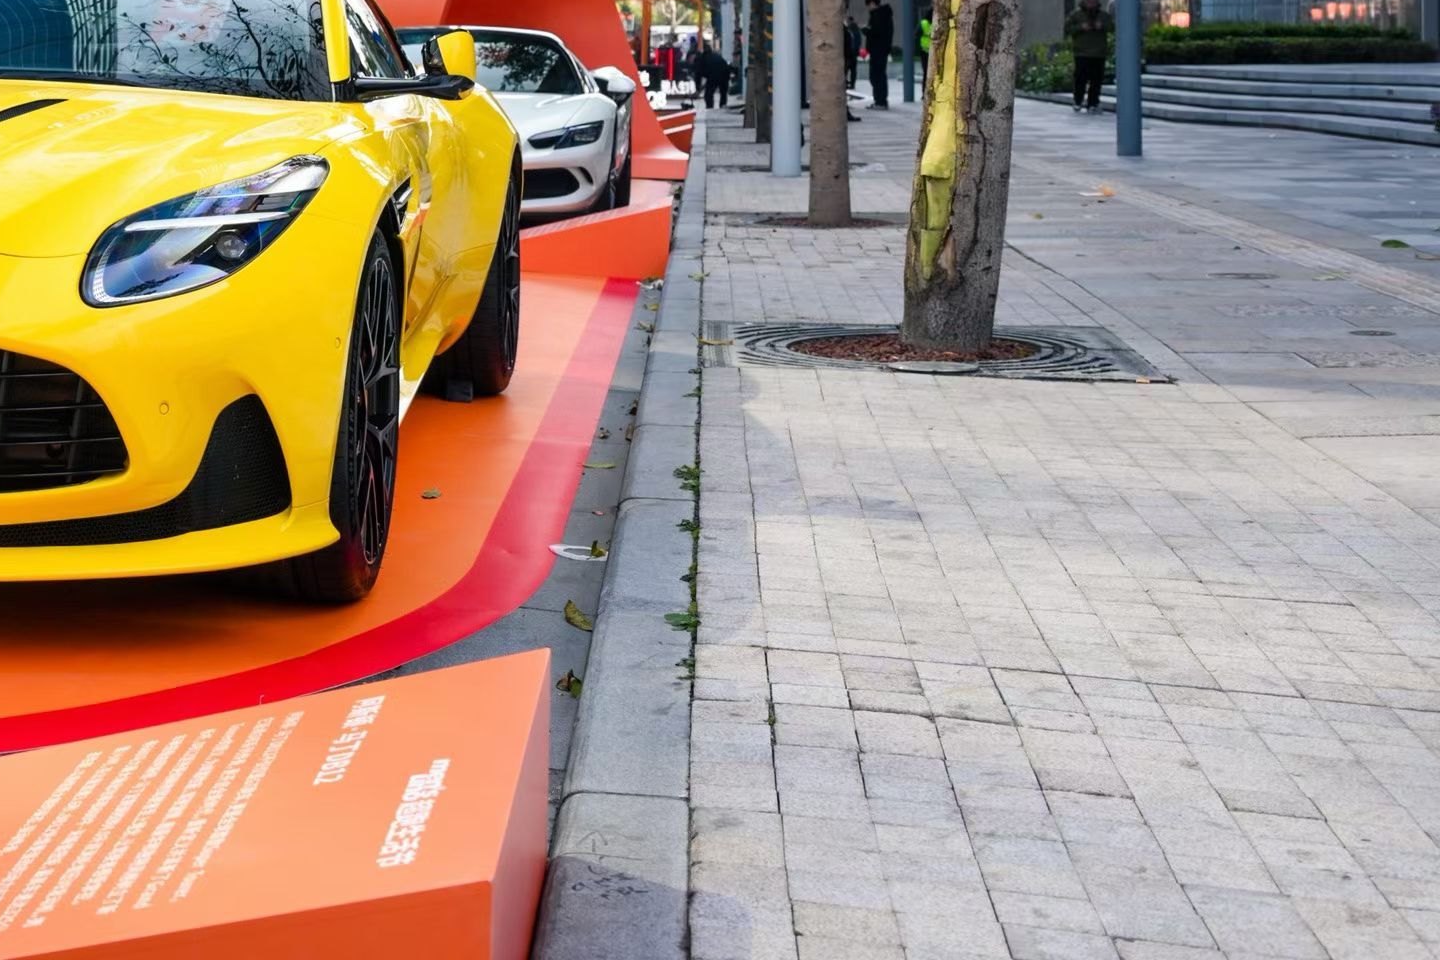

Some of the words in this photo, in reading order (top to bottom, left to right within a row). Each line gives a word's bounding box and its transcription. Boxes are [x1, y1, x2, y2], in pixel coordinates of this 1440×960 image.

[401, 773, 431, 801] uno
[418, 757, 450, 798] men's
[376, 798, 435, 868] 超跑生活节
